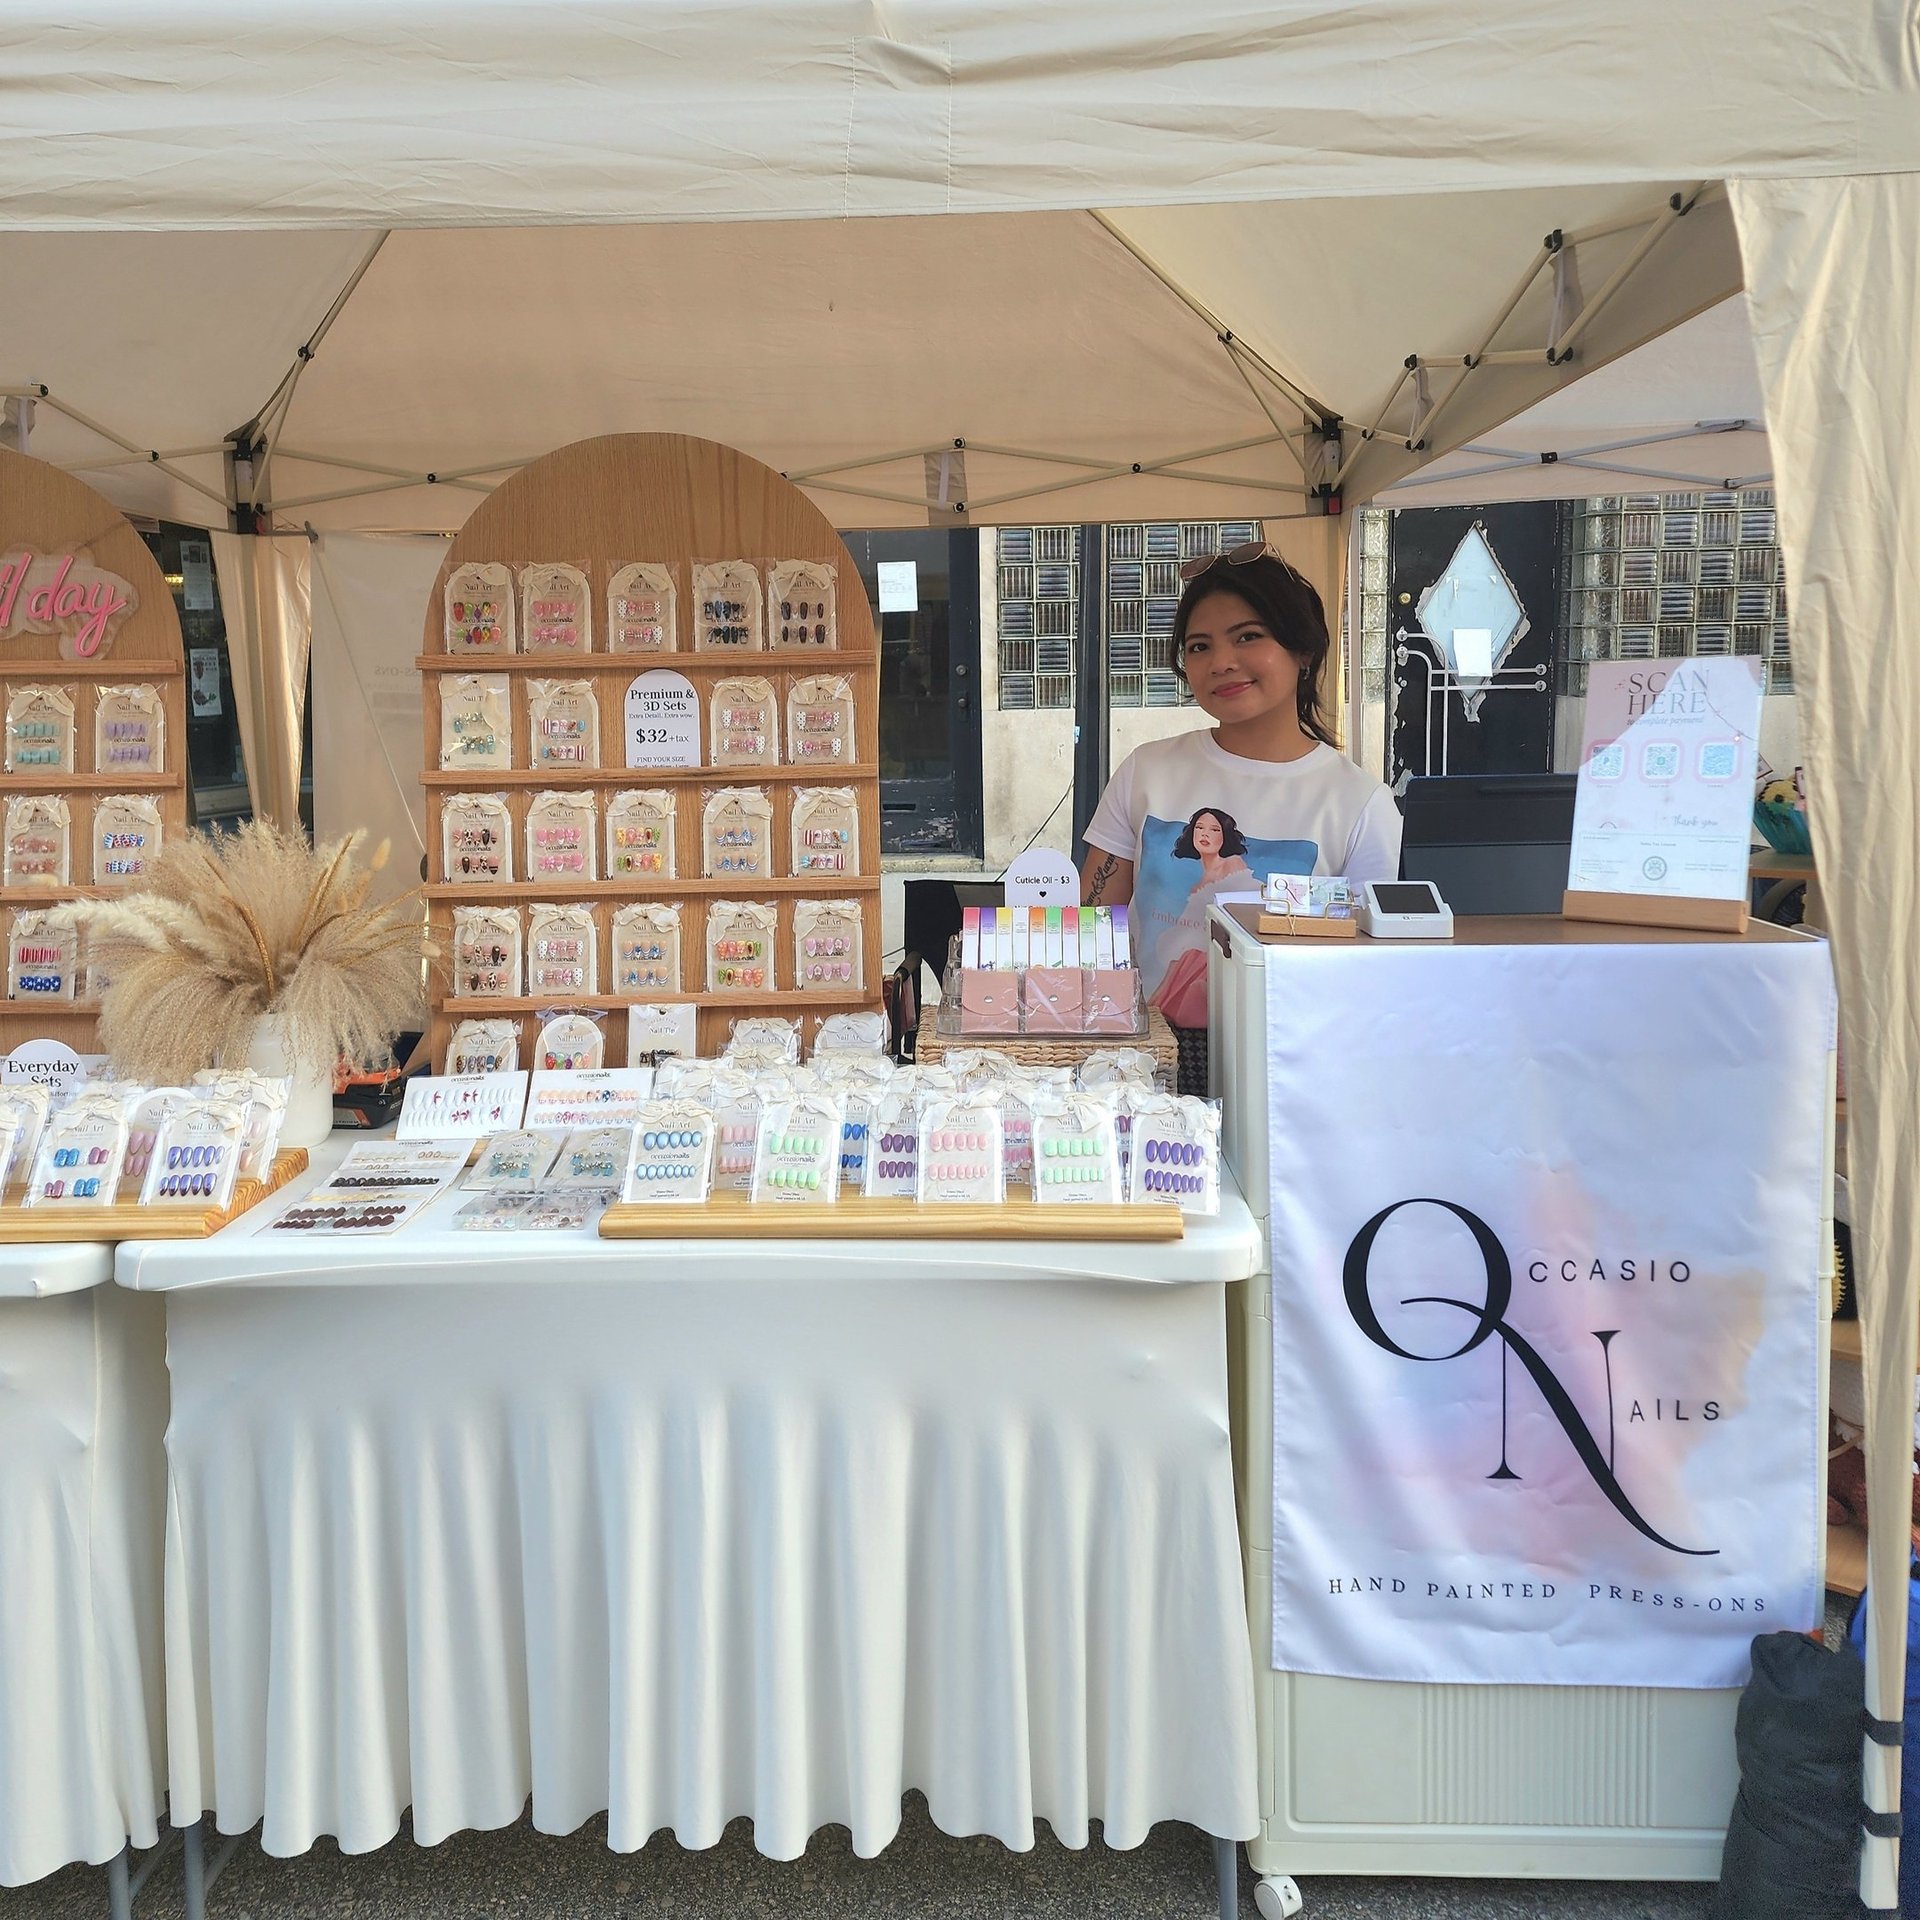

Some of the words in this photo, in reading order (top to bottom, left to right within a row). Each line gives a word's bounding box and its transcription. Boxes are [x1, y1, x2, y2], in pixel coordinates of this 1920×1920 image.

[27, 554, 127, 657] day
[1628, 669, 1710, 694] SCAN
[631, 689, 683, 699] Premium
[685, 689, 694, 699] &
[643, 701, 660, 711] 3D
[663, 701, 687, 711] Sets
[1628, 691, 1706, 715] HERE
[1015, 876, 1041, 884] Cuticle
[1042, 876, 1053, 884] Oil
[1060, 875, 1070, 884] $3
[8, 1060, 79, 1076] Everyday
[31, 1075, 62, 1088] Sets
[1057, 1118, 1073, 1126] Nail
[1328, 1578, 1406, 1595] HAND
[1427, 1583, 1556, 1599] PAINTED
[1589, 1584, 1766, 1612] PRESS-ONS
